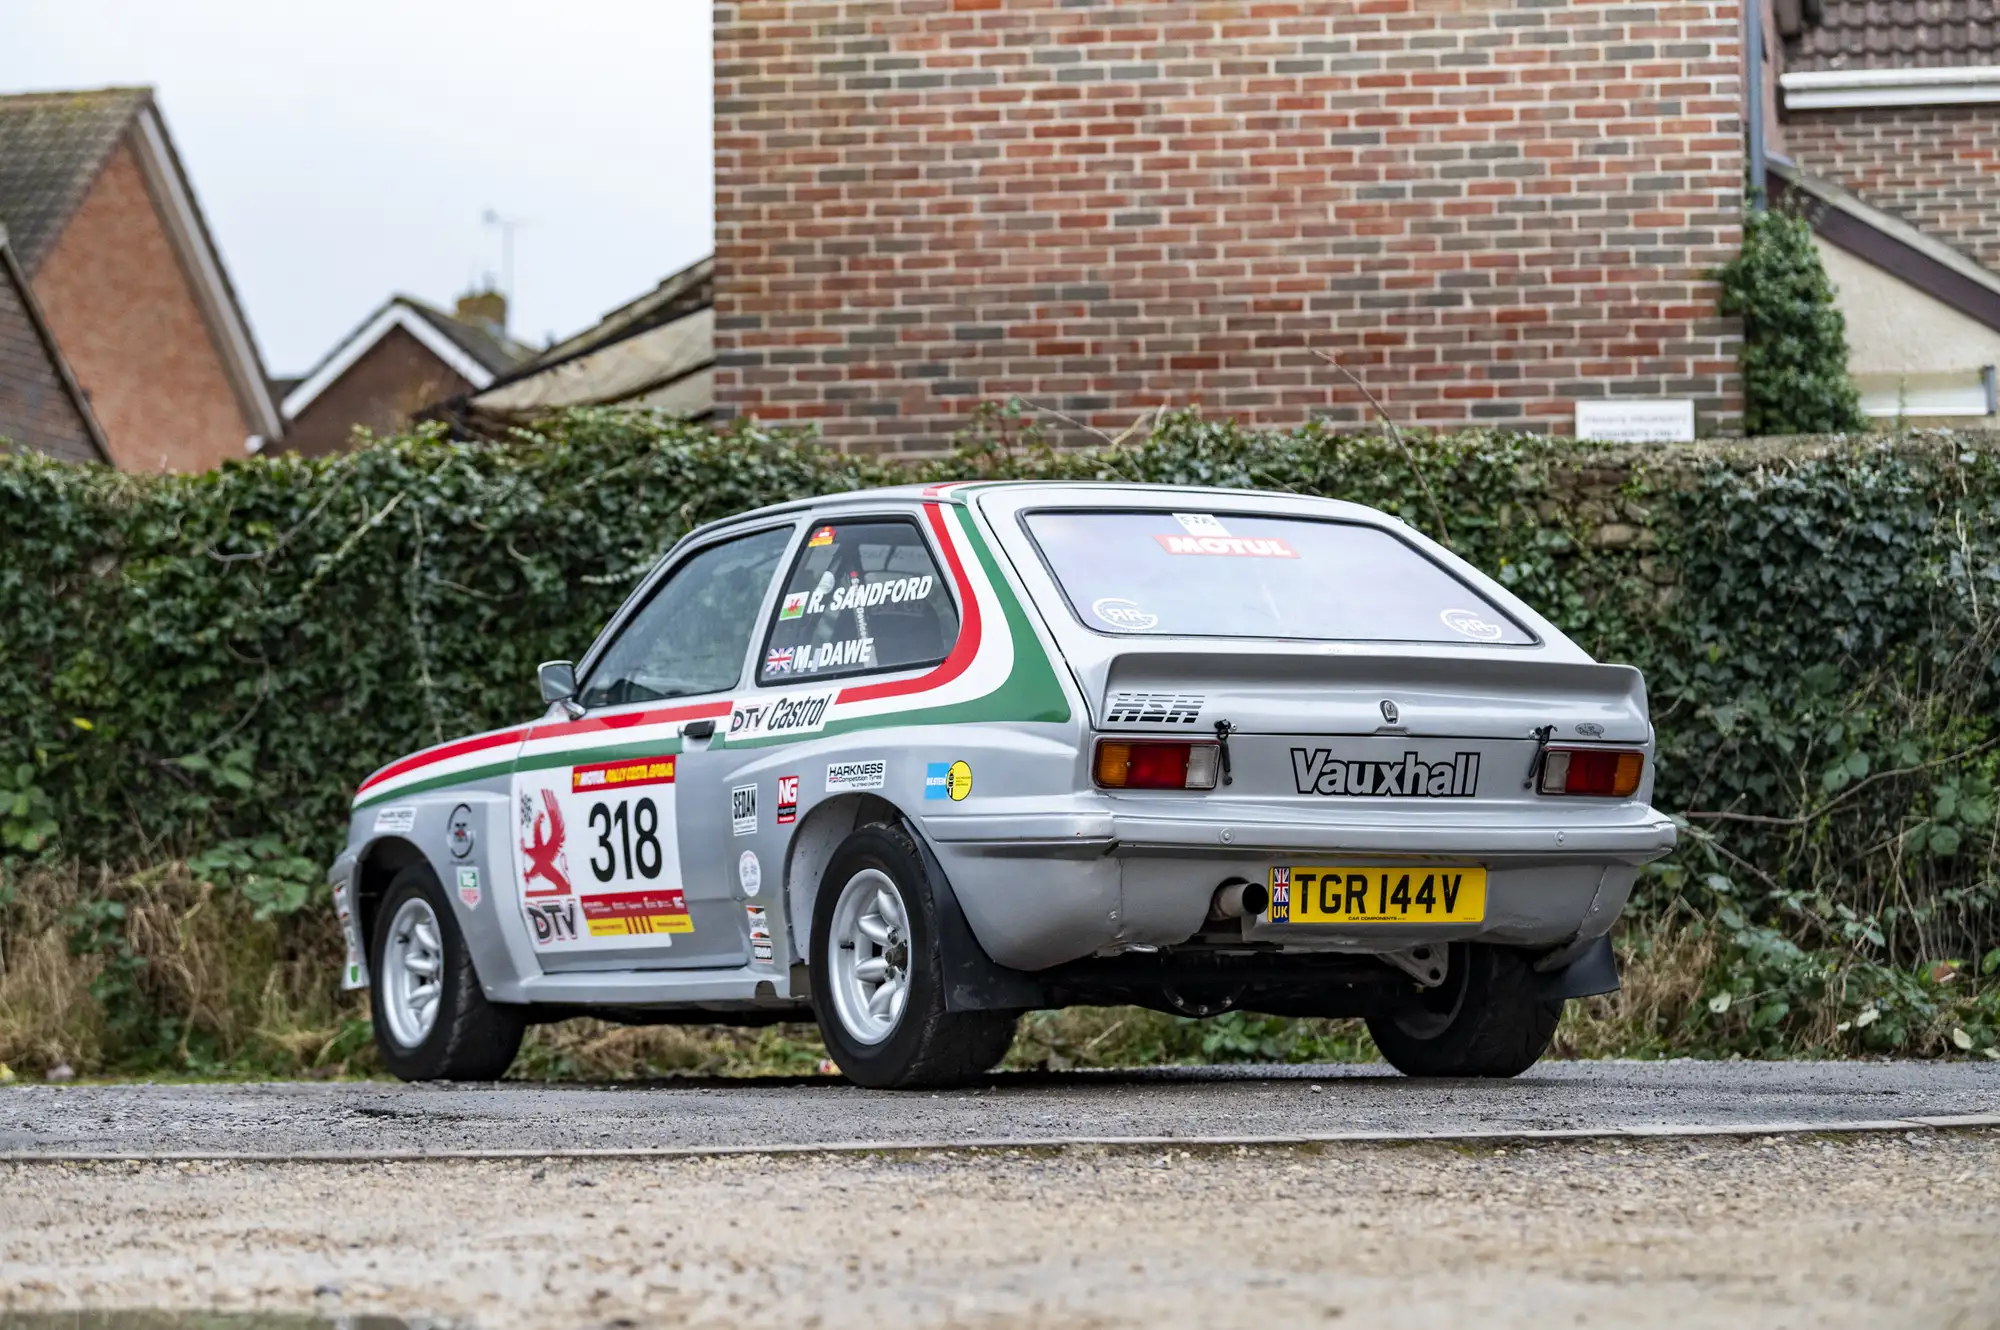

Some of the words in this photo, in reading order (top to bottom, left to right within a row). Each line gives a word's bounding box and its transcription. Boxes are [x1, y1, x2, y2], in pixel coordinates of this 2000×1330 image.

[1166, 537, 1292, 556] MOTUL
[830, 575, 933, 611] SANDFORD
[818, 637, 875, 667] DAWE
[729, 705, 770, 734] DTV
[767, 693, 832, 731] Castrol
[828, 762, 884, 777] HARKNESS
[1290, 748, 1480, 797] Vauxhall
[734, 789, 756, 820] SEDAN
[778, 778, 798, 804] NG
[588, 797, 663, 882] 318
[1294, 874, 1368, 914] TGR
[1379, 874, 1462, 914] 144V
[526, 900, 577, 942] DTV
[1273, 906, 1288, 918] UK
